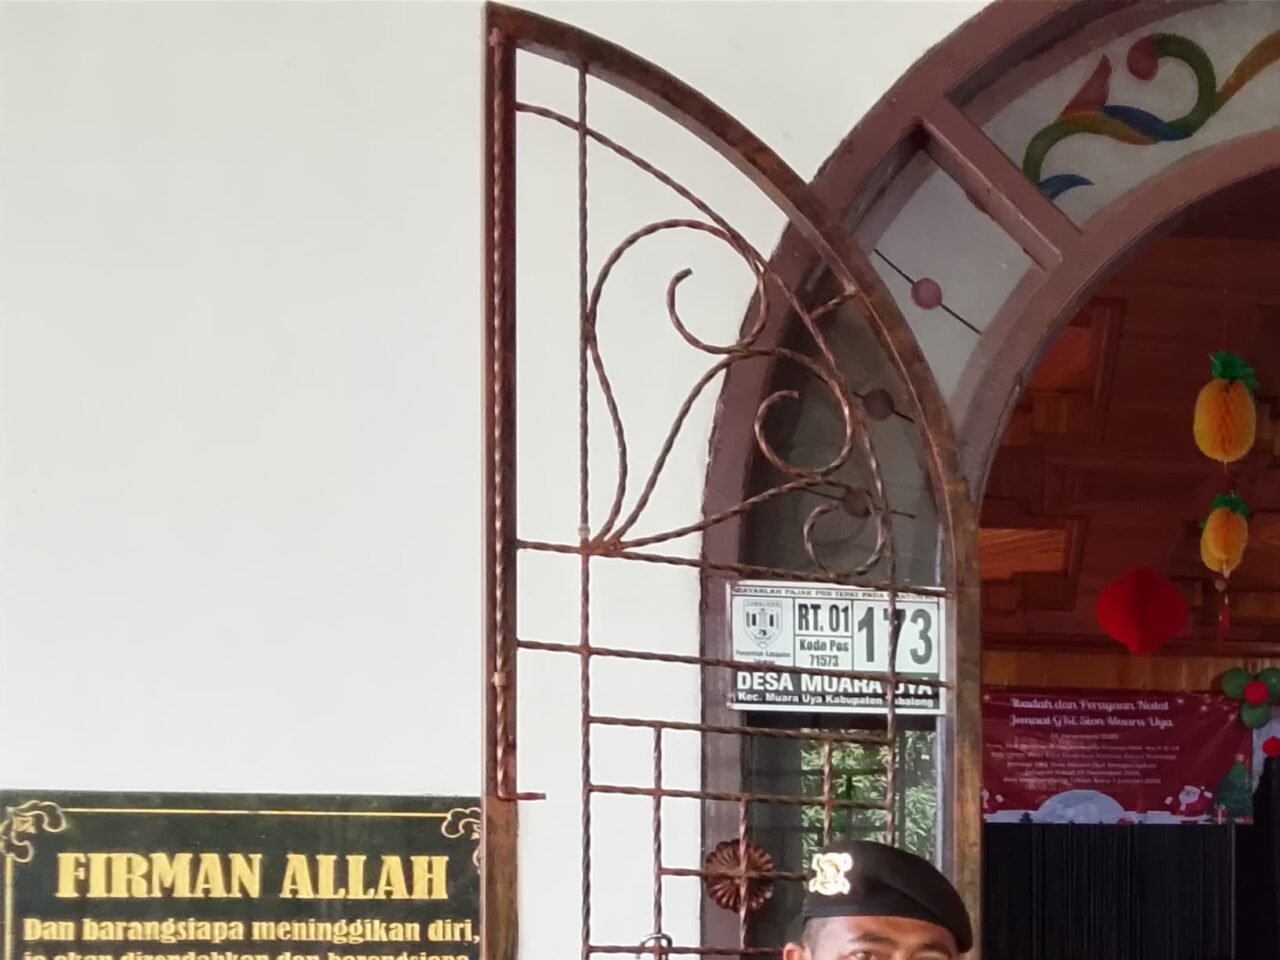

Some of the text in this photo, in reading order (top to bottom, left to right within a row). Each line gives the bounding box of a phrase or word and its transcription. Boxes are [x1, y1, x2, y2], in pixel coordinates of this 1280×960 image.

[798, 603, 849, 632] RT. 01
[800, 639, 849, 652] Kode Pos
[858, 606, 932, 665] 173
[809, 654, 839, 667] 71573
[737, 670, 794, 692] DESA
[800, 674, 883, 694] MUARA
[738, 691, 934, 708] Kec. Muara Uya Kabupaten abalong
[1054, 699, 1077, 709] dan
[1136, 700, 1169, 710] Natal
[1149, 717, 1173, 730] Uya
[55, 852, 449, 899] FIRMAN ALLAH
[23, 918, 480, 944] Dan barangsiapa meninggikan diri,
